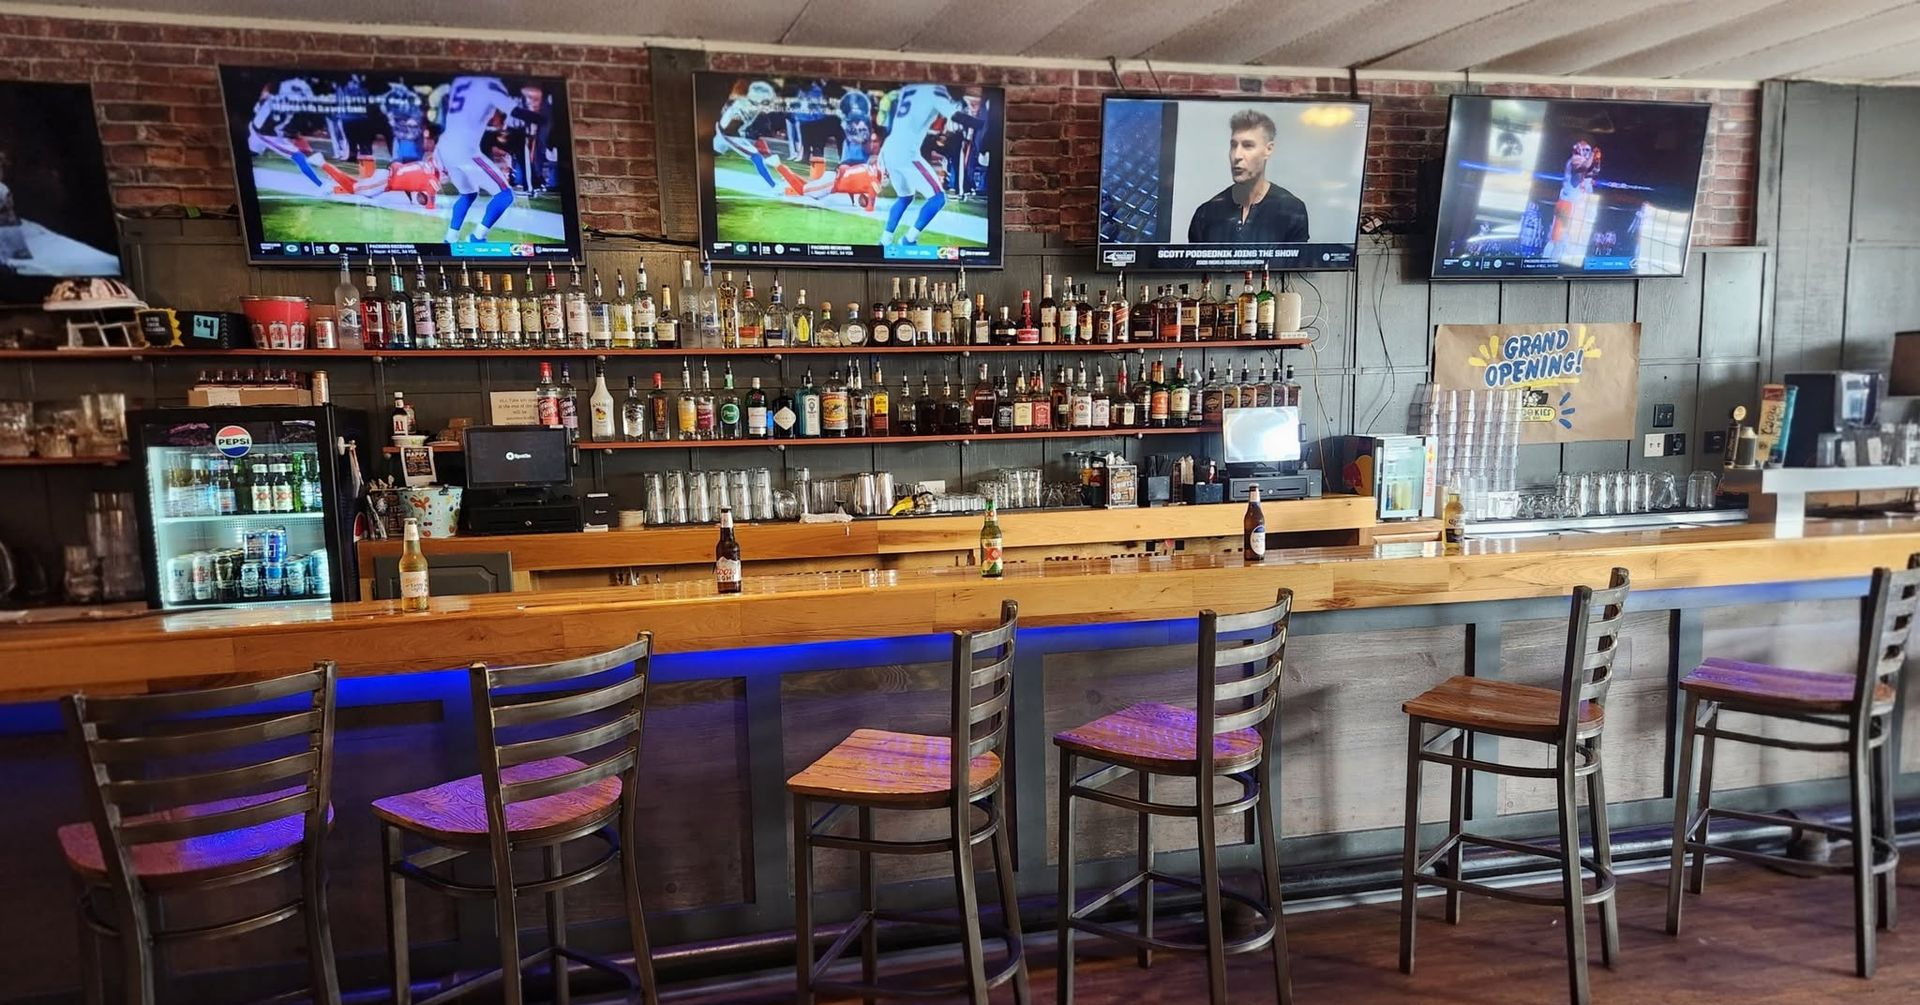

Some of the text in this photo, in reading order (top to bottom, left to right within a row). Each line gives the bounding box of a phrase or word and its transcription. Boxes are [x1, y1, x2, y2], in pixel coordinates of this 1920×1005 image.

[1158, 249, 1299, 258] SCOTT PODSEDNIK JOINS THE SHOW
[366, 305, 379, 313] UV
[196, 317, 214, 337] $4
[1504, 329, 1569, 360] GRAND
[1485, 348, 1584, 387] OPENING!
[218, 438, 249, 446] PEPSI
